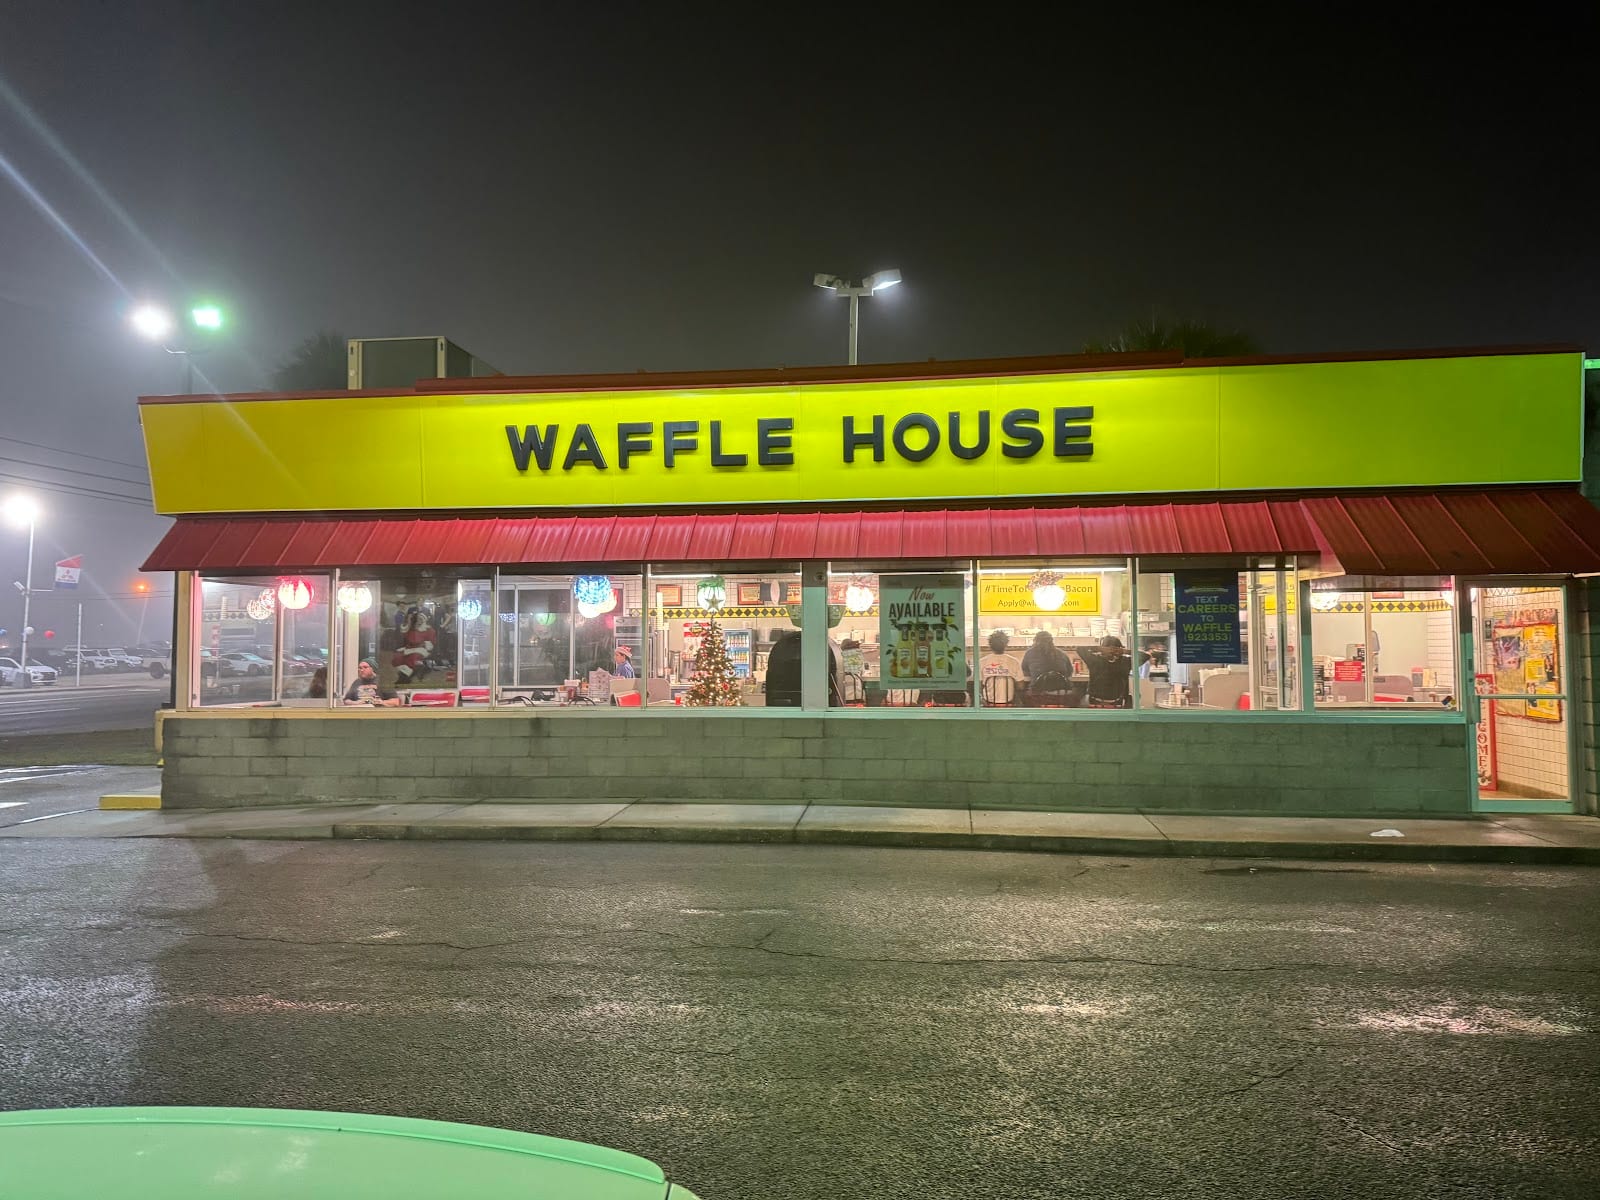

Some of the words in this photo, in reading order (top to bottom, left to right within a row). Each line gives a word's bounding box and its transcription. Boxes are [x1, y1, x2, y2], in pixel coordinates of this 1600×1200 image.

[505, 417, 795, 471] WAFFLE
[842, 406, 1094, 463] HOUSE
[909, 585, 935, 601] Now
[1194, 595, 1219, 603] TEXT
[888, 601, 956, 619] AVAILABLE
[1178, 604, 1237, 614] CAREERS
[1200, 614, 1214, 622] TO
[1182, 622, 1233, 632] WAFFLE
